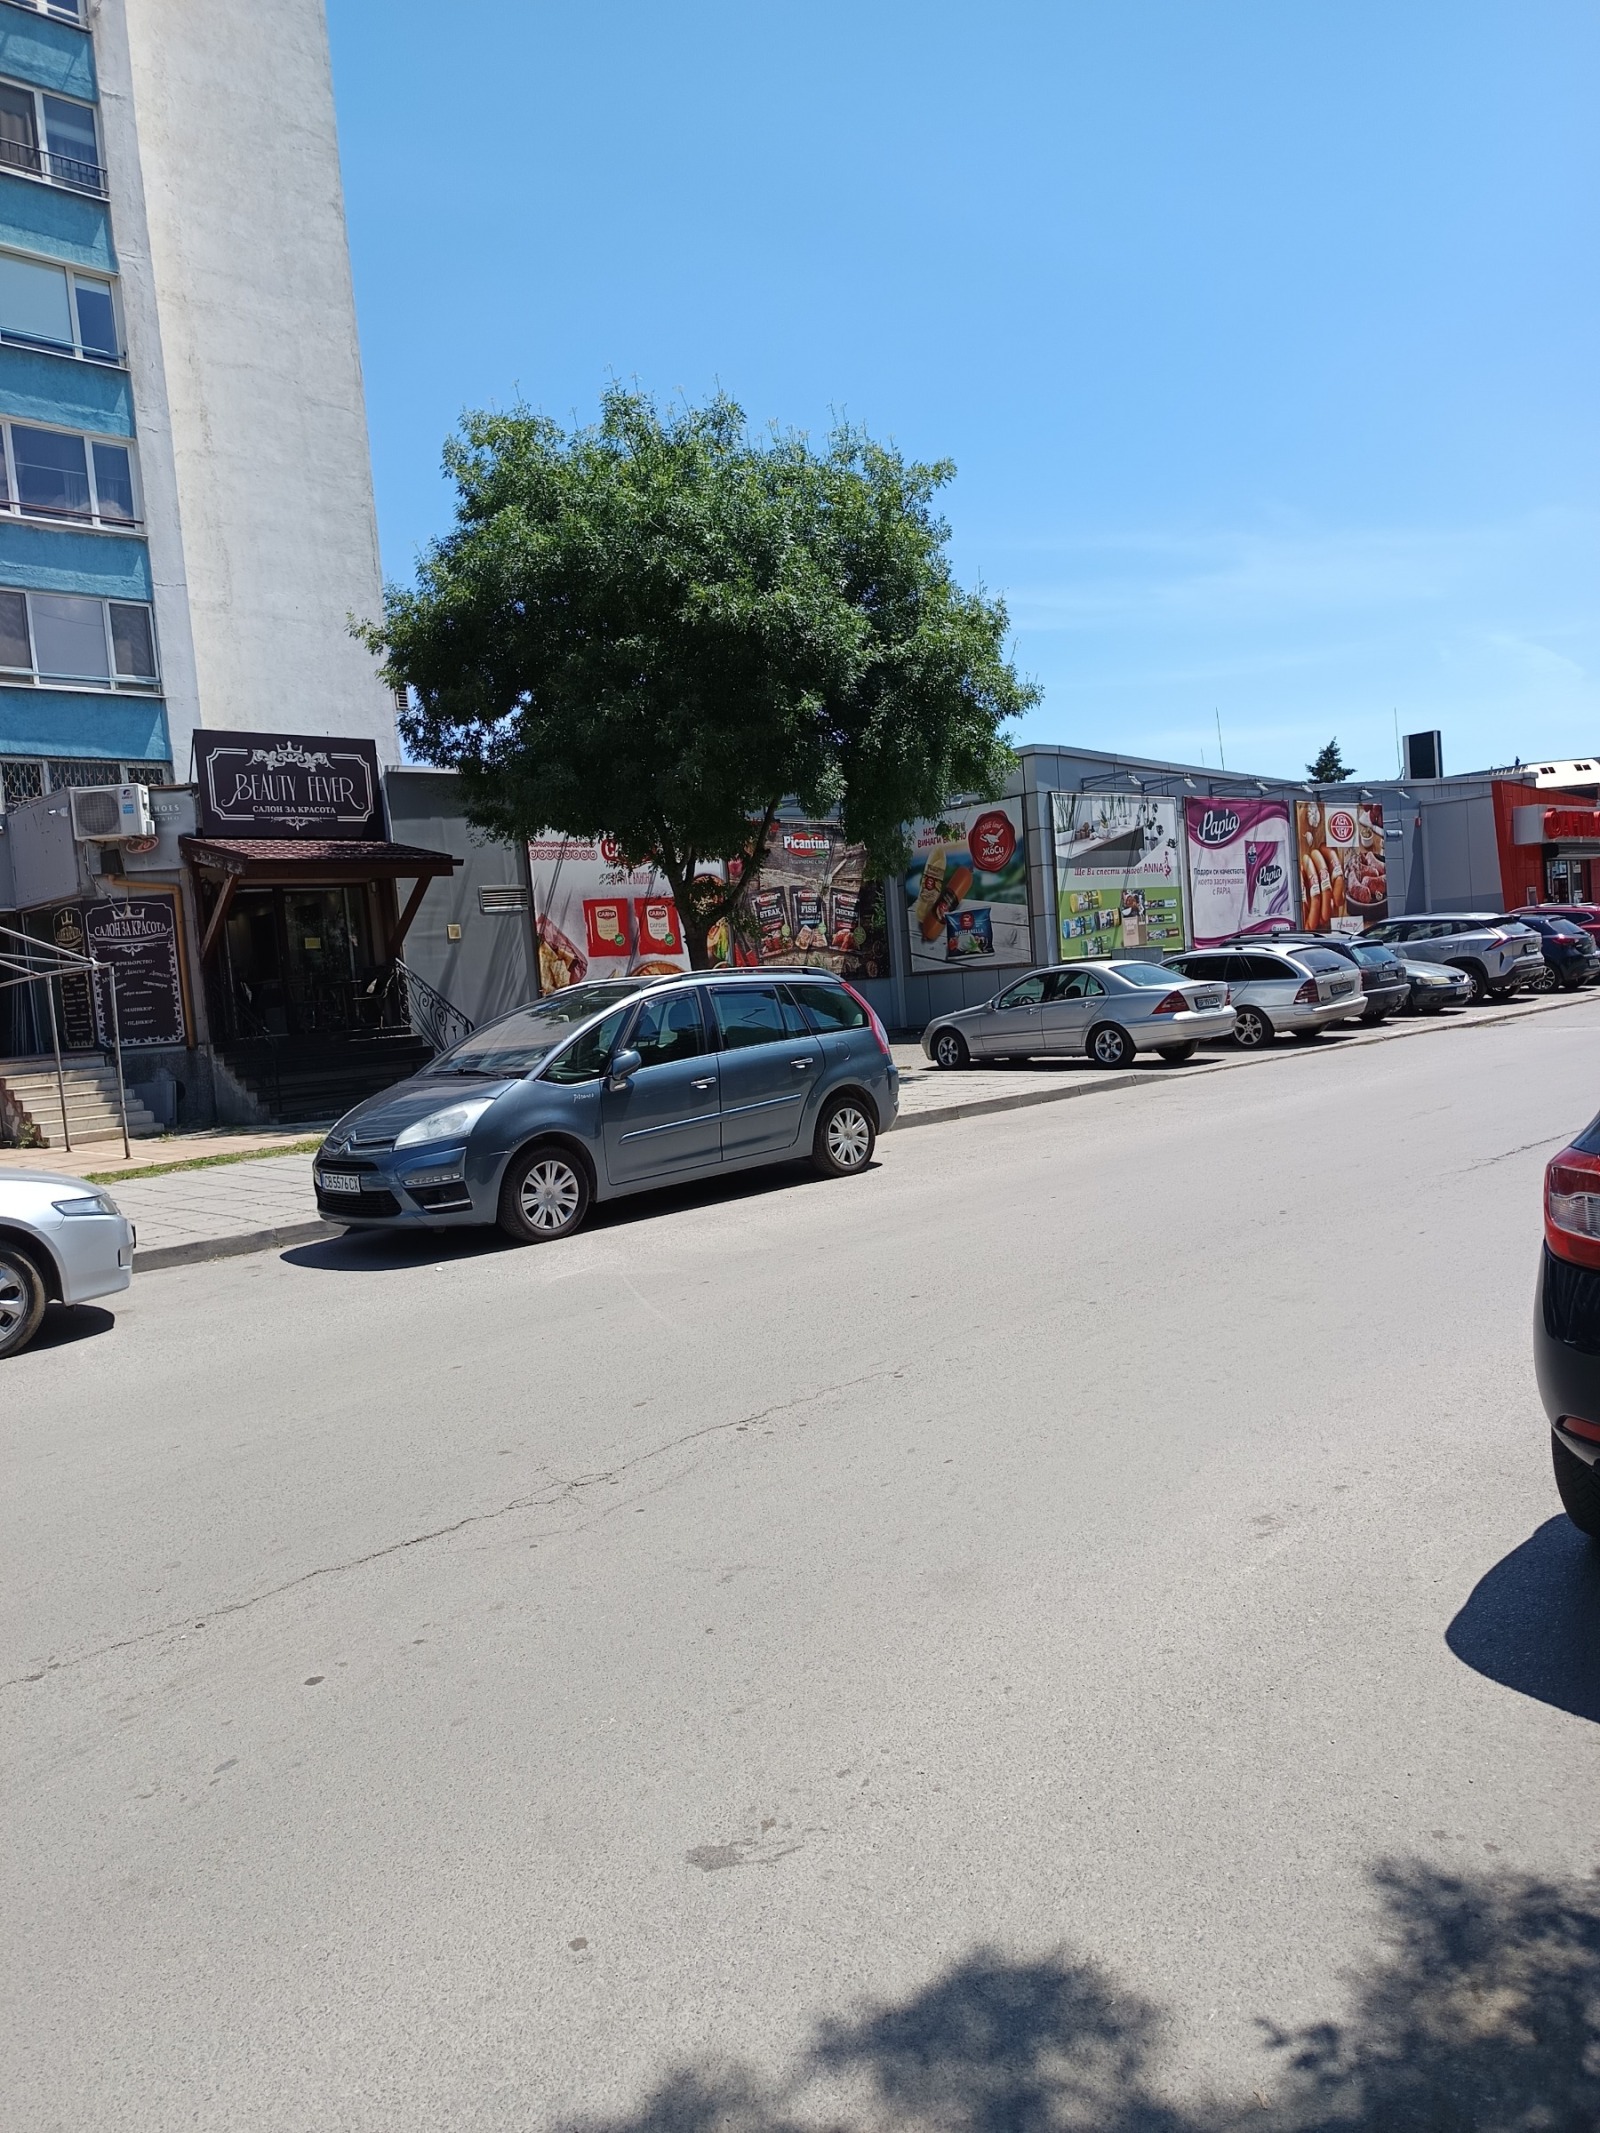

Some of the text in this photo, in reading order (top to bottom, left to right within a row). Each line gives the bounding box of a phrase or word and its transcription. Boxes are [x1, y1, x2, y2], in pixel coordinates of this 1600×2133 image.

[221, 774, 365, 809] BEAUTY FEVER
[252, 805, 283, 813] САЛОН
[298, 806, 336, 814] КРАСОТА
[1202, 808, 1237, 841] Papia
[783, 835, 830, 849] Picantina
[917, 838, 942, 848] ВИНАГИ
[982, 845, 1004, 856] ЖоСи
[1074, 867, 1085, 876] Ще
[1086, 867, 1095, 876] Ви
[1143, 863, 1164, 873] ANNA
[1194, 868, 1212, 876] Подари
[1259, 865, 1281, 886] Papia
[1214, 878, 1244, 886] заслужаваш
[1216, 887, 1231, 895] PAPIA
[760, 908, 781, 918] STEAK
[801, 905, 818, 913] FISH
[94, 922, 121, 937] САЛОН
[121, 921, 132, 937] ЗА
[131, 920, 167, 936] КРАСОТА
